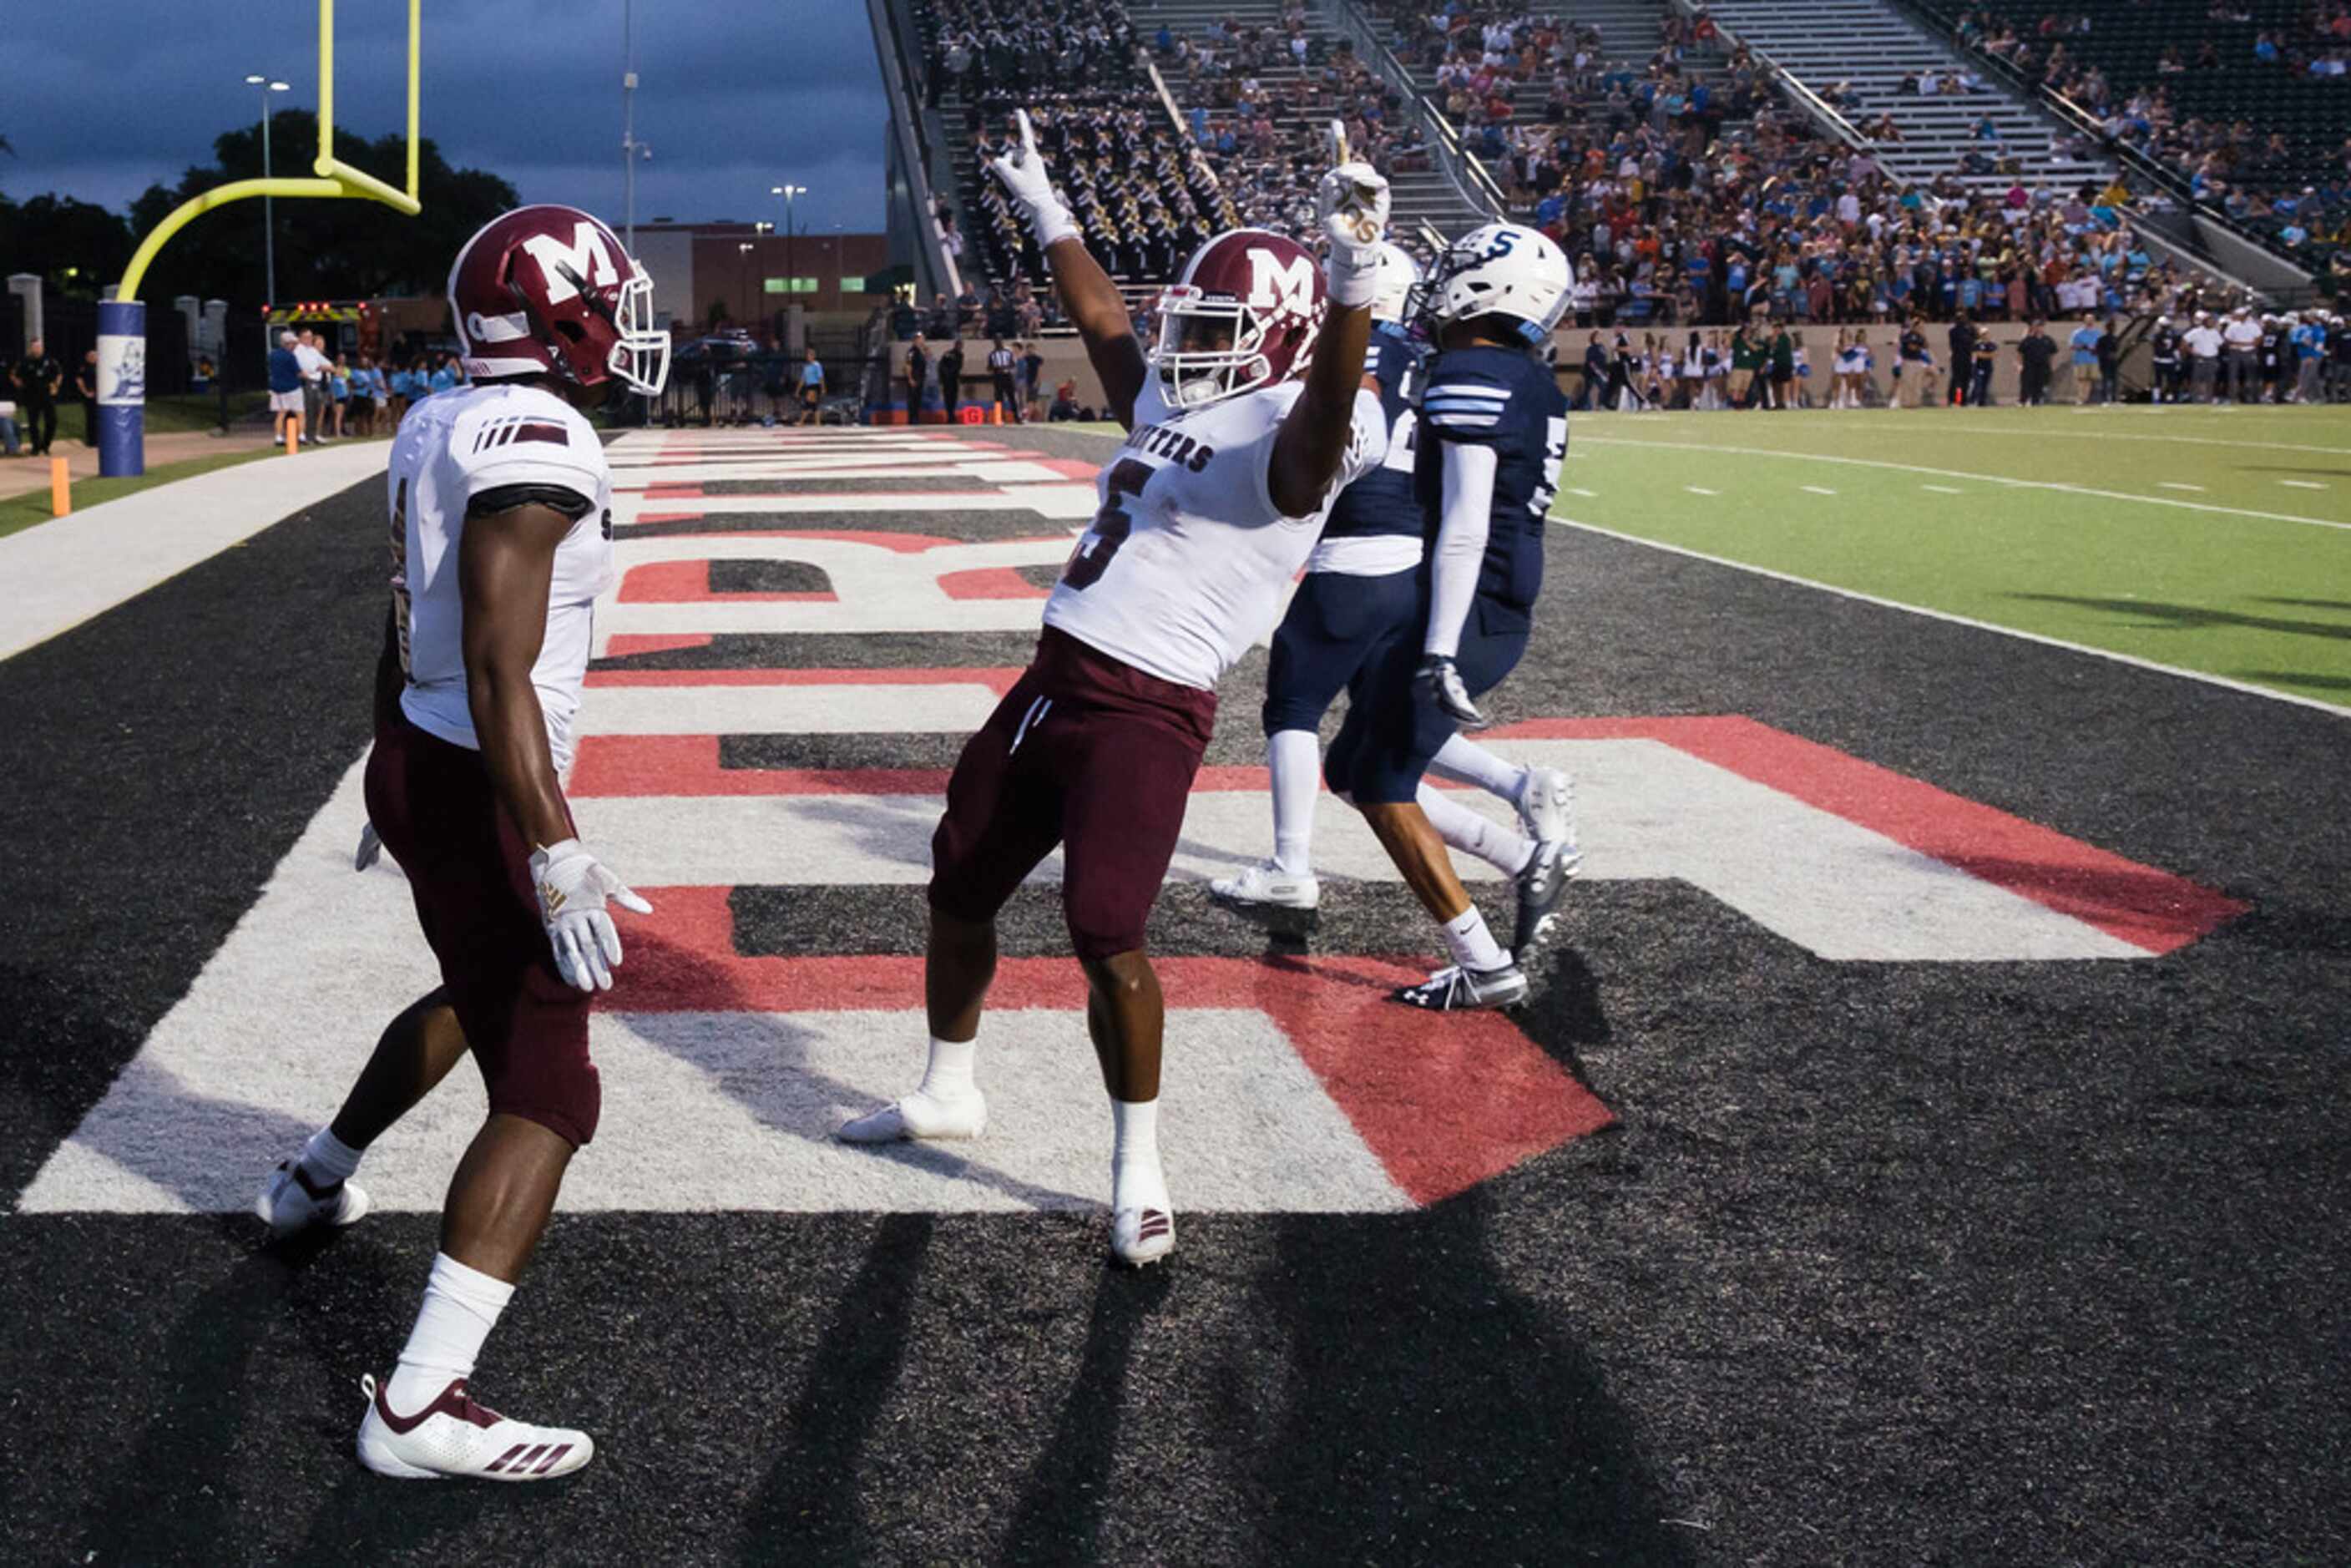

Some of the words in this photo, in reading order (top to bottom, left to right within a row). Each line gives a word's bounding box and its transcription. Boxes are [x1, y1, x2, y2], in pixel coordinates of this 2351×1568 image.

[522, 221, 619, 306] M
[1246, 248, 1315, 317] M
[1061, 457, 1156, 591] 5
